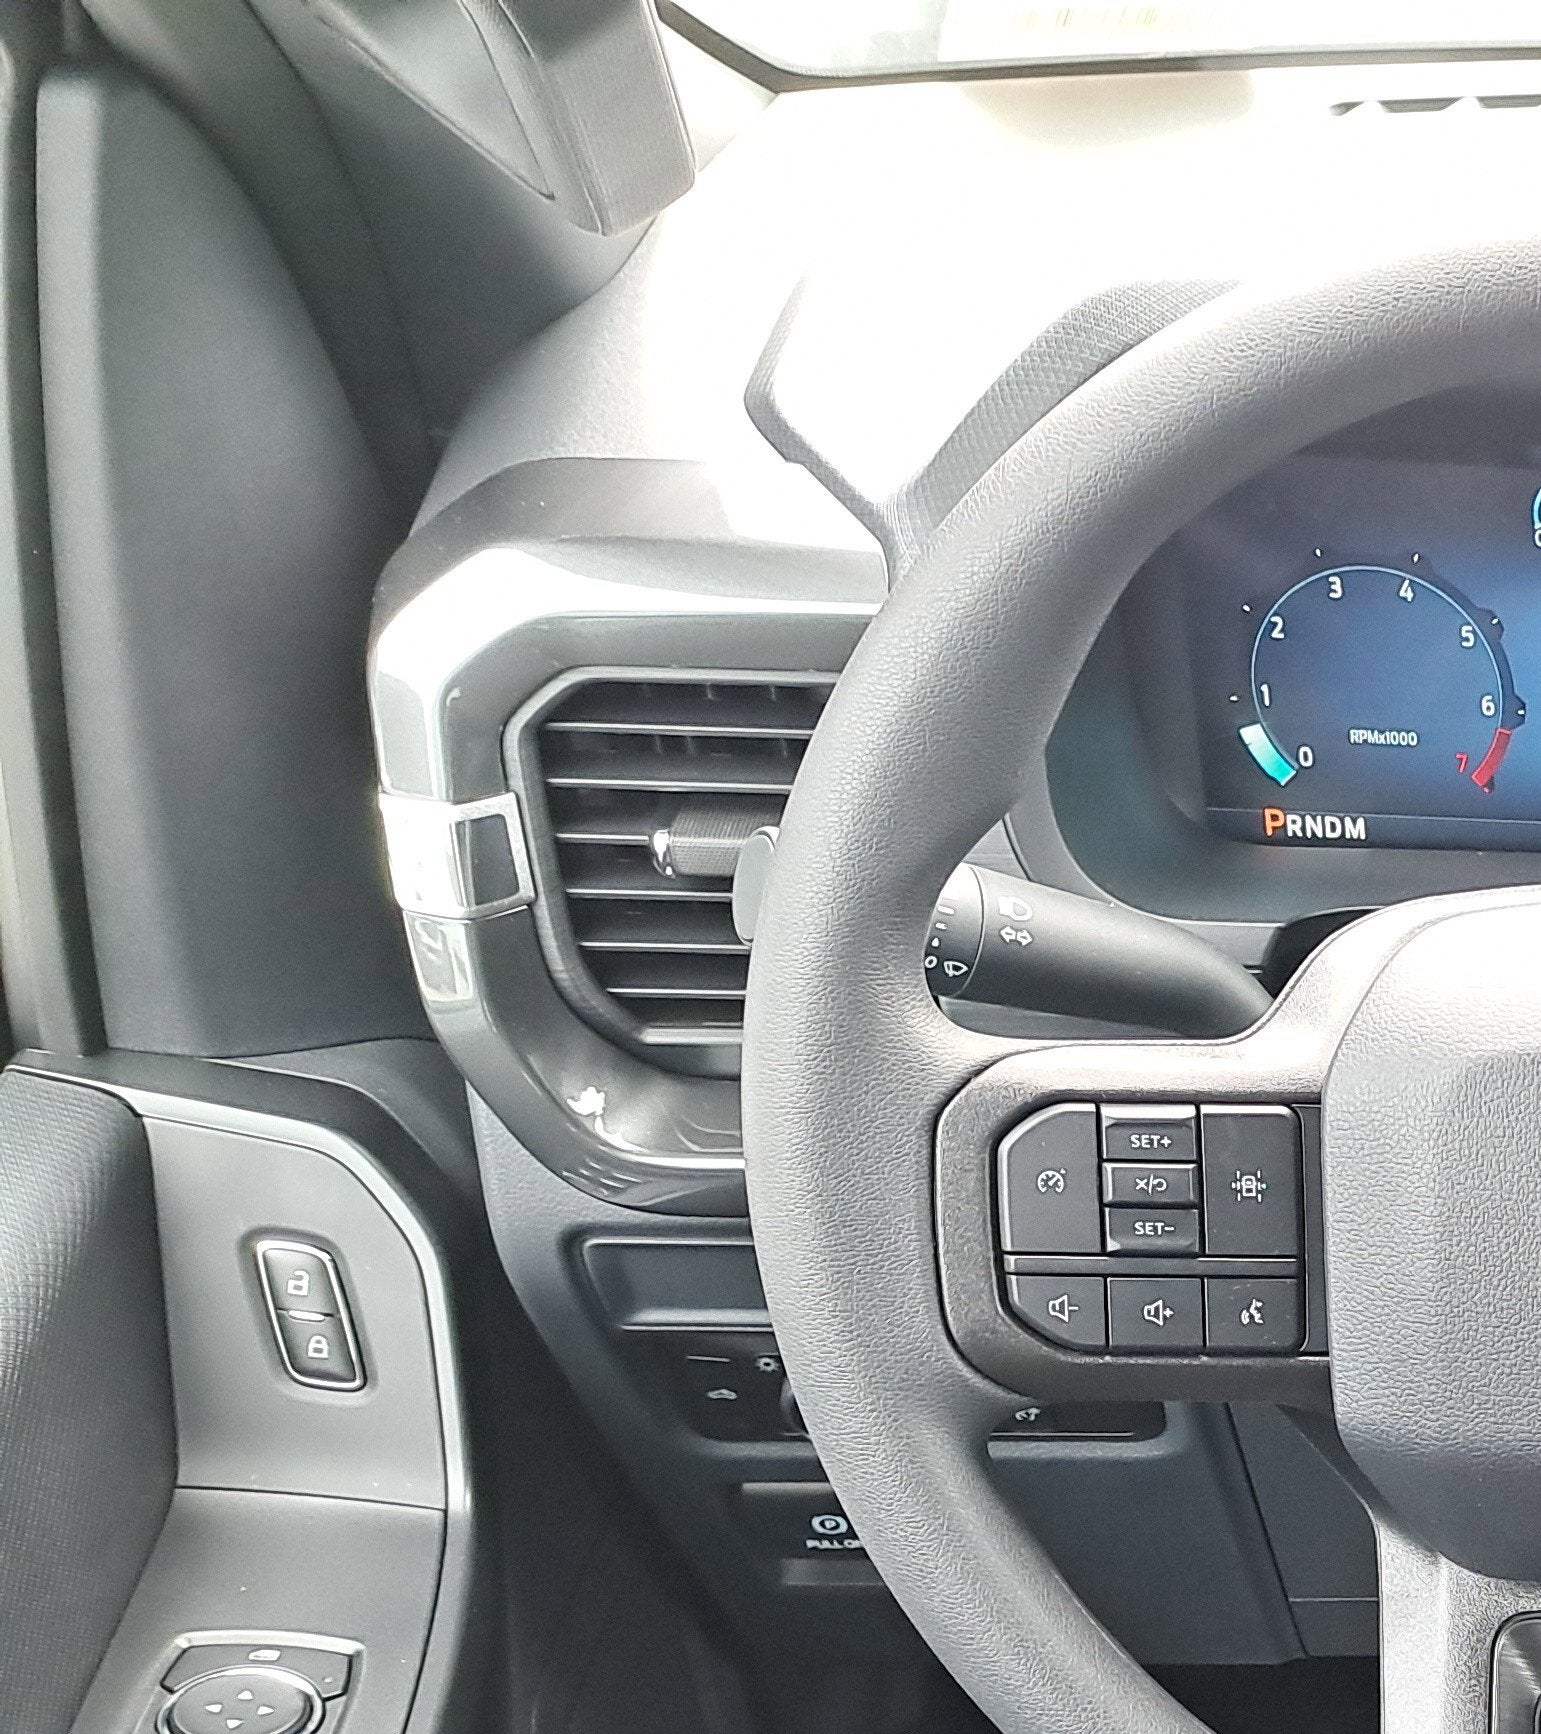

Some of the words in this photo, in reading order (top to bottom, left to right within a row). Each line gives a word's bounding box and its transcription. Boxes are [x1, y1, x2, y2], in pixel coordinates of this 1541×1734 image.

[1328, 577, 1343, 599] 3
[1399, 579, 1414, 602] 4
[1271, 617, 1285, 639] 2
[1460, 626, 1474, 648] 5
[1260, 685, 1271, 706] 1
[1481, 696, 1494, 716] 6
[1349, 729, 1418, 747] RPMx1000
[1297, 747, 1313, 767] 0
[1456, 754, 1468, 773] 7
